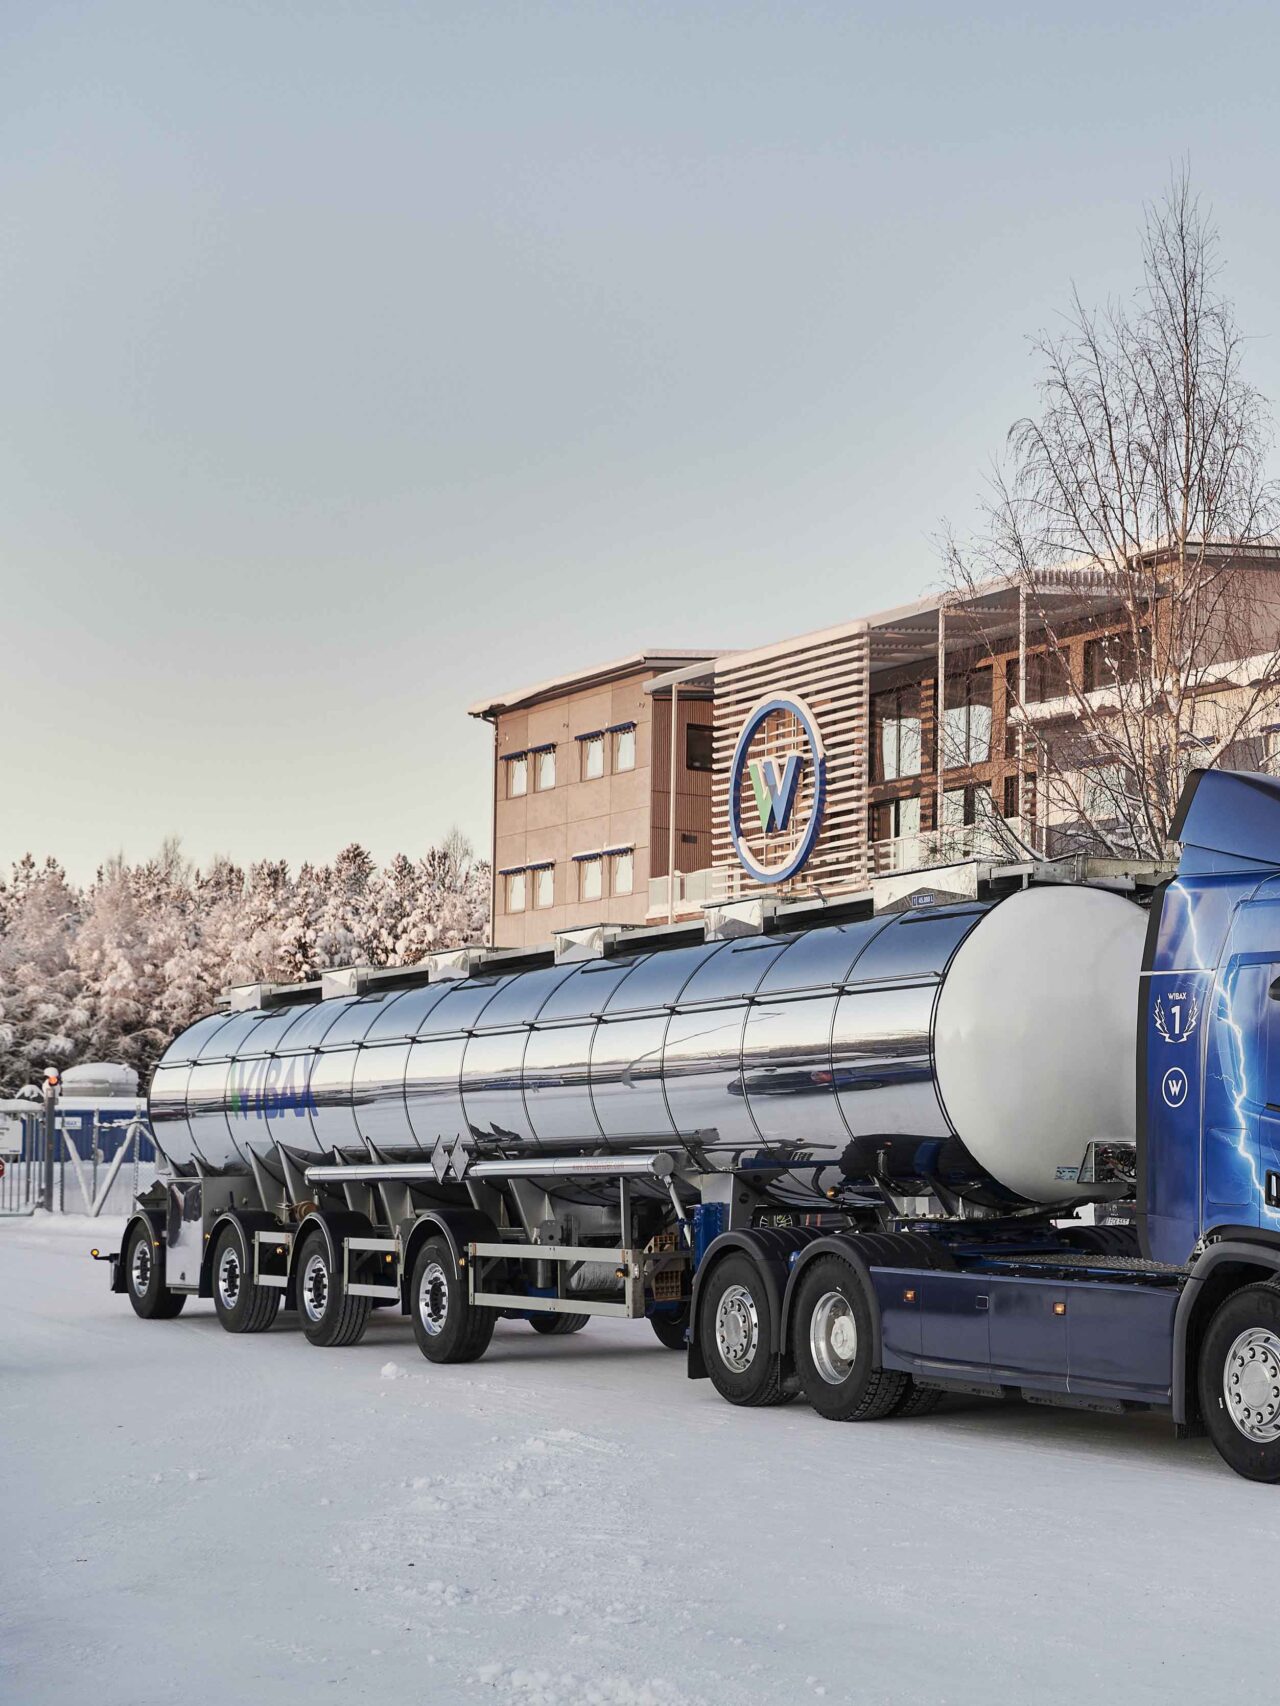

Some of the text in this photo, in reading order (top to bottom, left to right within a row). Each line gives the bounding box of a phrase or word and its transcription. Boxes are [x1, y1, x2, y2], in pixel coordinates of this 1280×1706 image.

[1167, 992, 1187, 1000] WIBAX
[1171, 1005, 1181, 1034] 1
[230, 1053, 323, 1120] WIBAX
[1168, 1079, 1182, 1096] W
